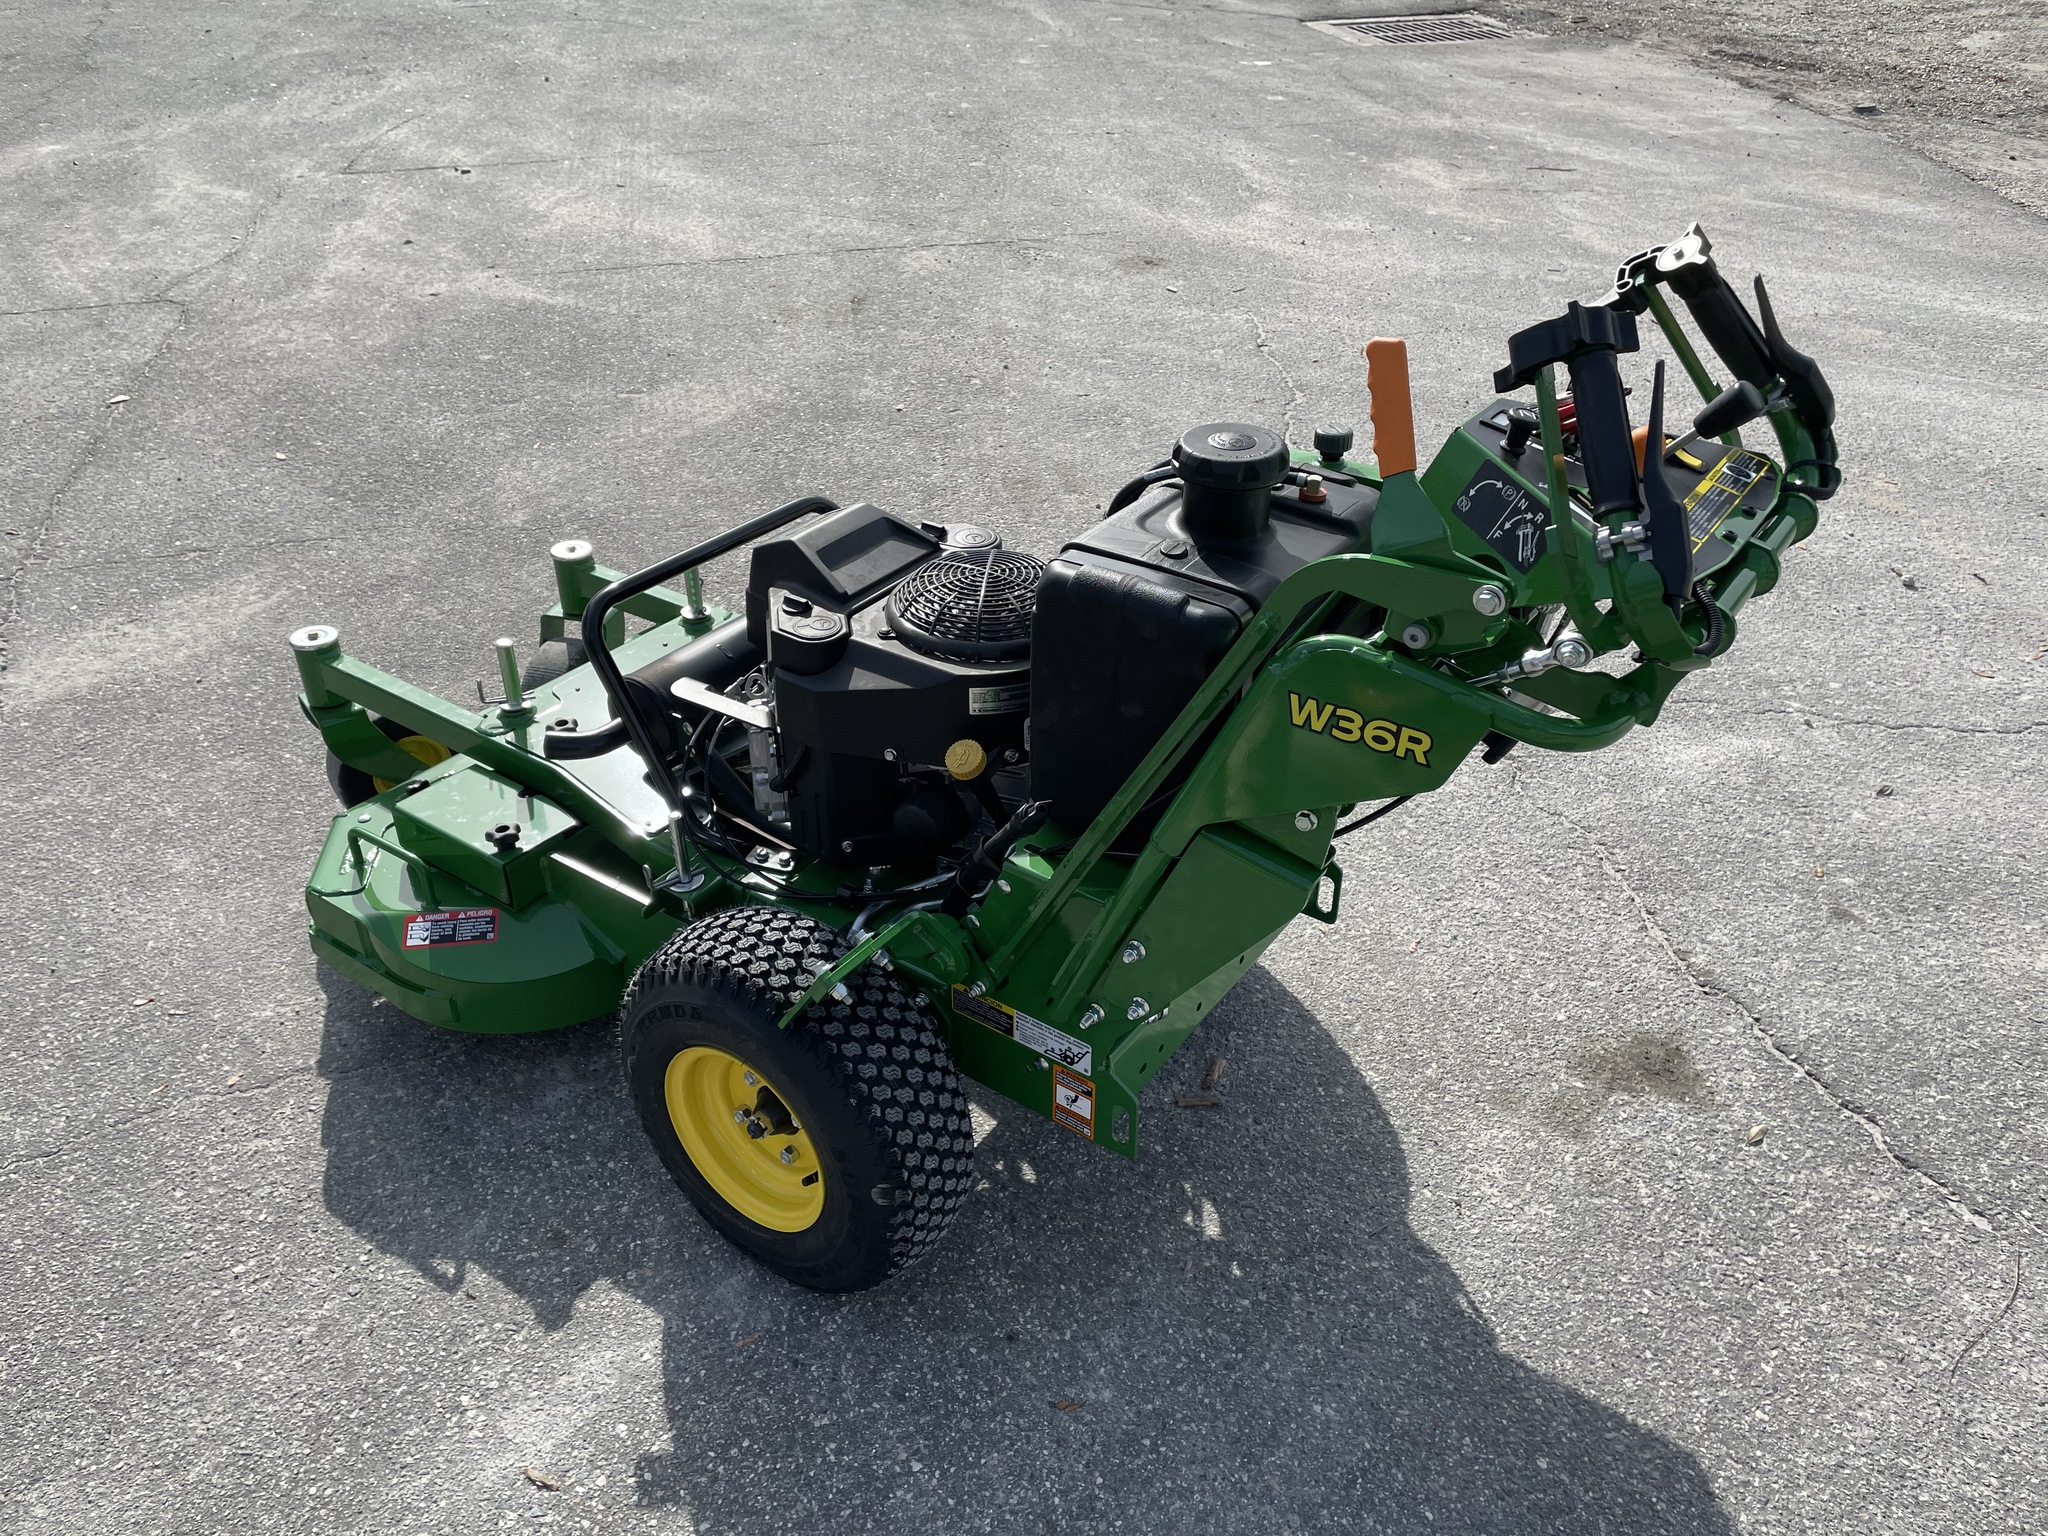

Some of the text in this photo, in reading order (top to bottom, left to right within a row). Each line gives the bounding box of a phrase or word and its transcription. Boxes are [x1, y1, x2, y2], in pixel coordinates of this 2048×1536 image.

[1517, 498, 1529, 510] N
[1534, 512, 1545, 524] R
[1493, 529, 1503, 539] F
[1288, 691, 1432, 767] W36R
[425, 912, 450, 921] DANGER
[467, 909, 493, 917] PELIGRO
